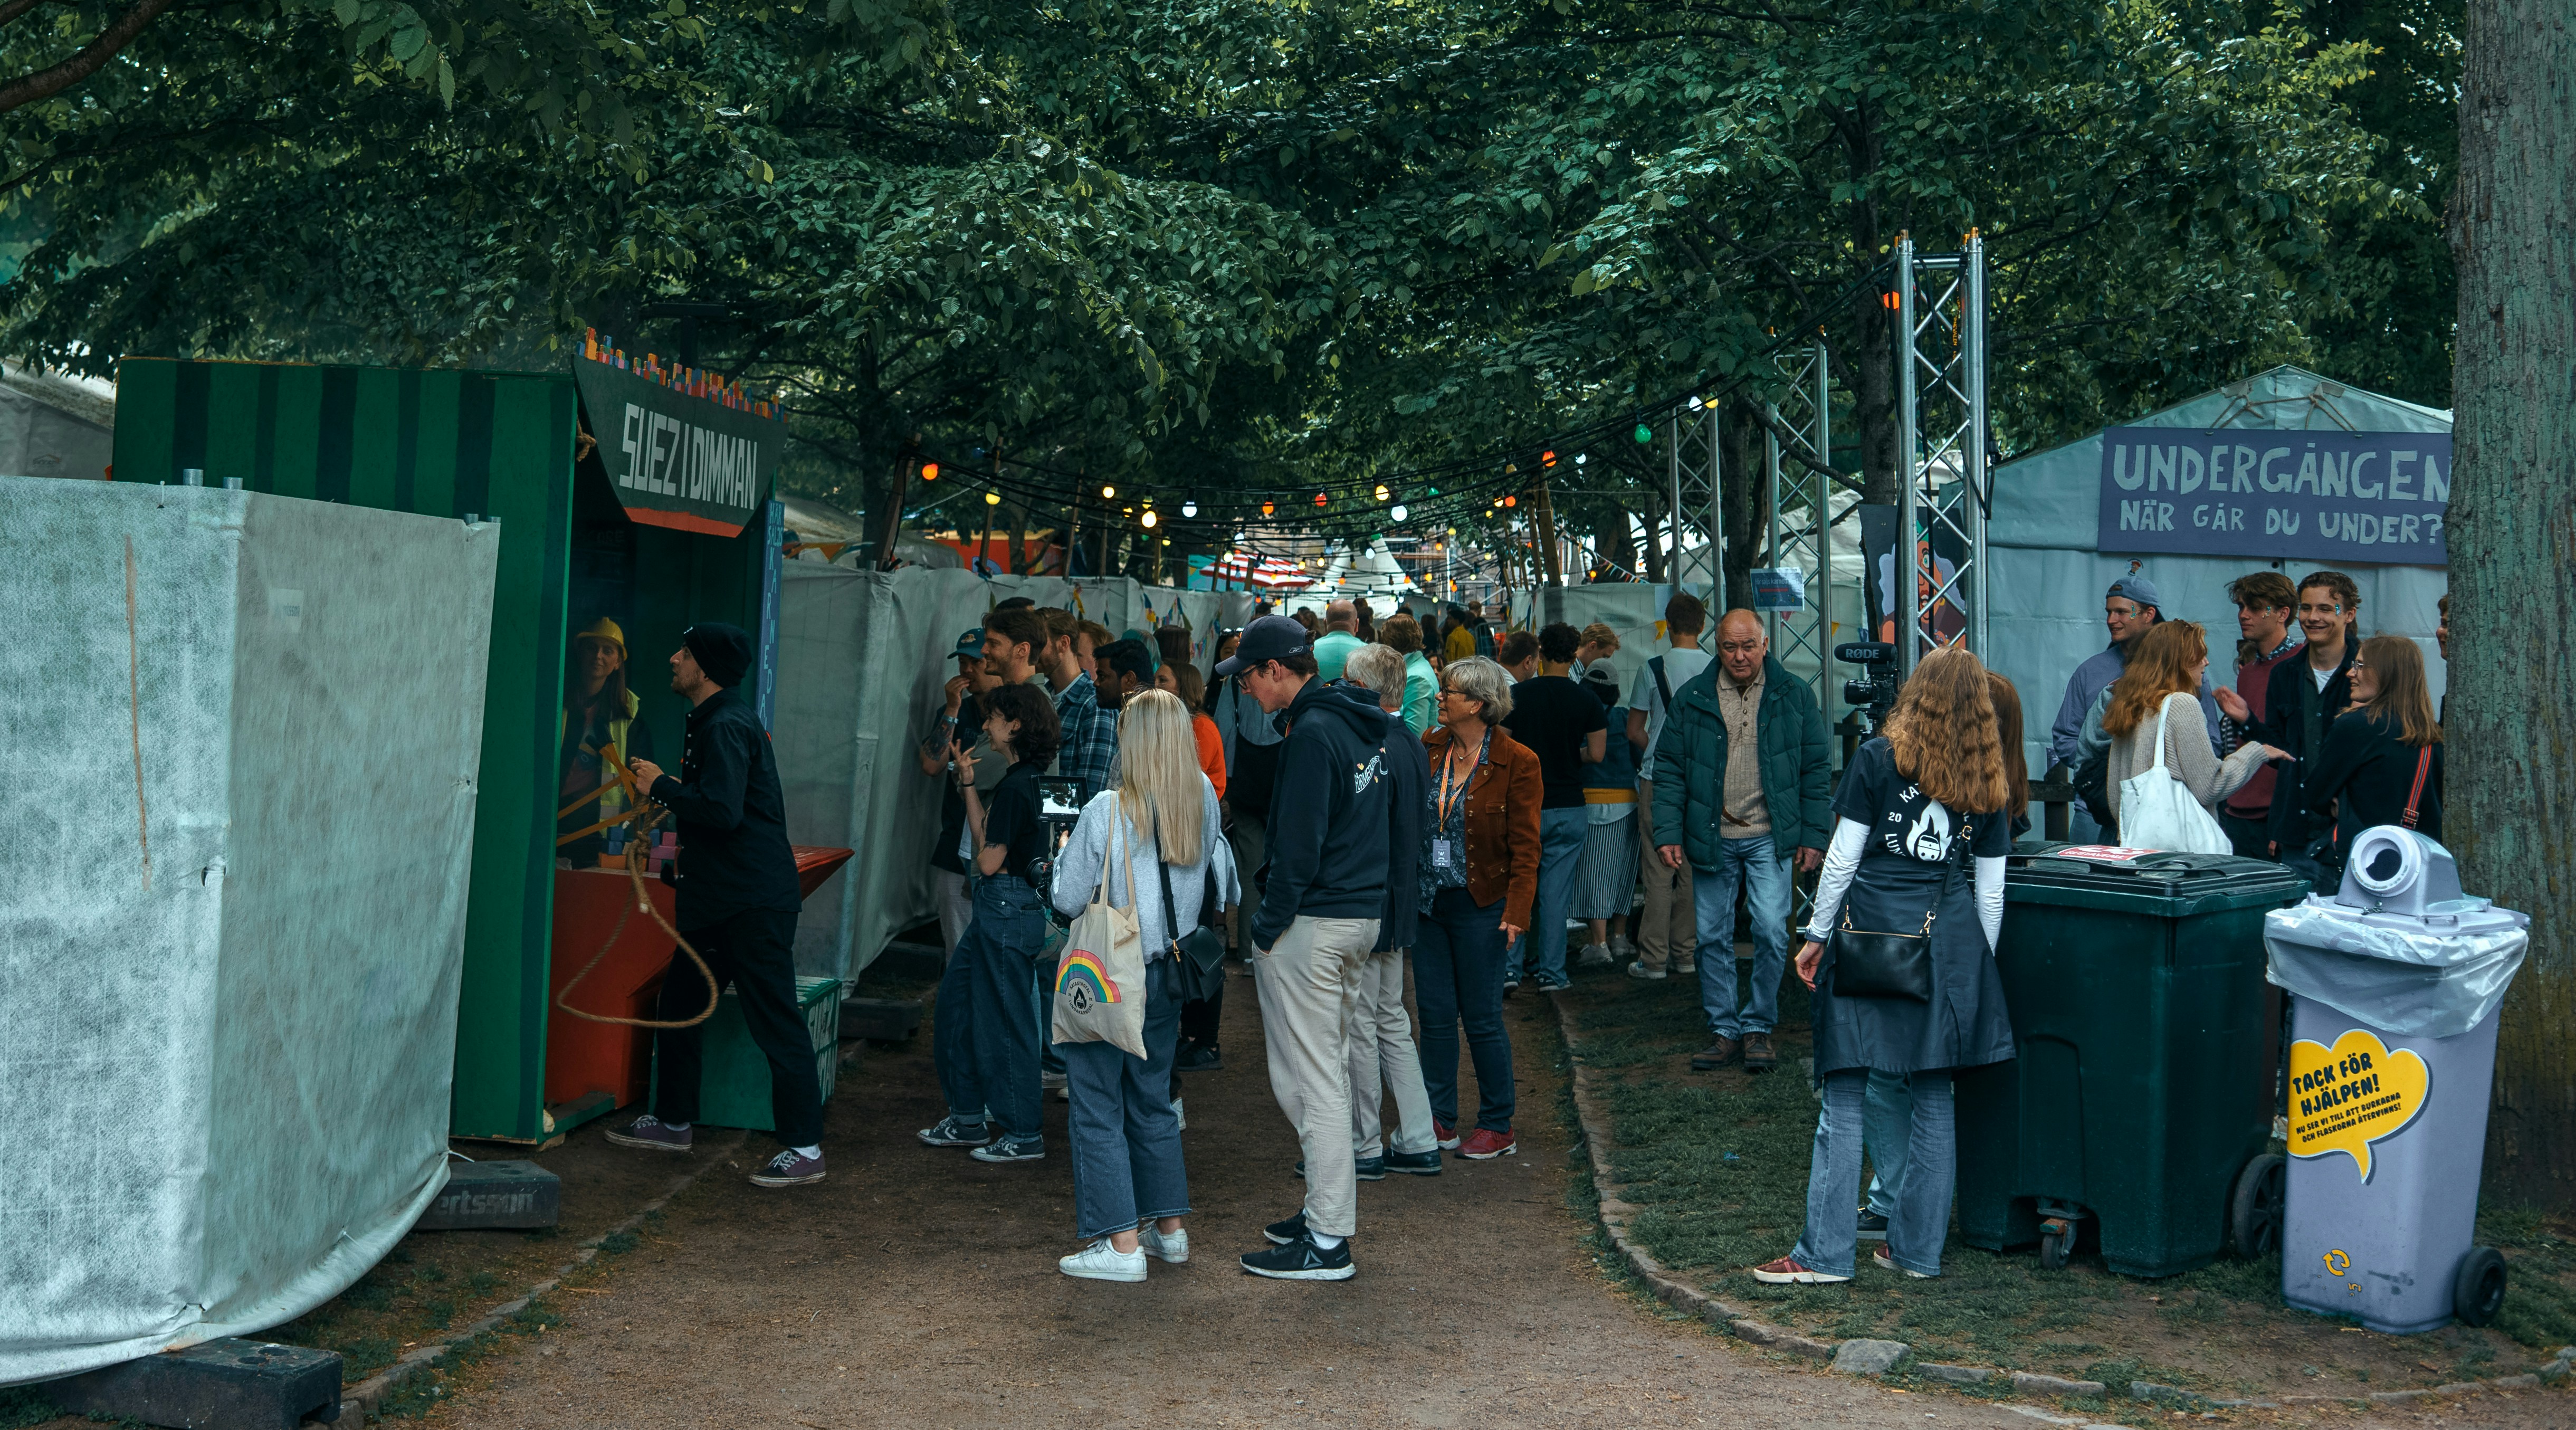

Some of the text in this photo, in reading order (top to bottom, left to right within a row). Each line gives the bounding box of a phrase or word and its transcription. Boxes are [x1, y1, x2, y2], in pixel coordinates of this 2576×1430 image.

[619, 402, 758, 510] SUEZ I DIMMAN
[2113, 442, 2450, 502] UNDERGÅNGEN
[769, 503, 782, 524] HÄR
[2120, 499, 2444, 545] NÄR GÅR DU UNDER?
[1846, 649, 1879, 659] RØDE
[1887, 812, 1903, 823] 20
[2292, 1052, 2373, 1095] TACK FÖR
[2301, 1073, 2381, 1117] HJÄLPEN!
[2296, 1092, 2402, 1135] NU SER VI TILL ATT BURKARNA
[2302, 1102, 2402, 1143] OCH FLASKORNA ÅTERVINNS!
[435, 1190, 533, 1216] ertsson
